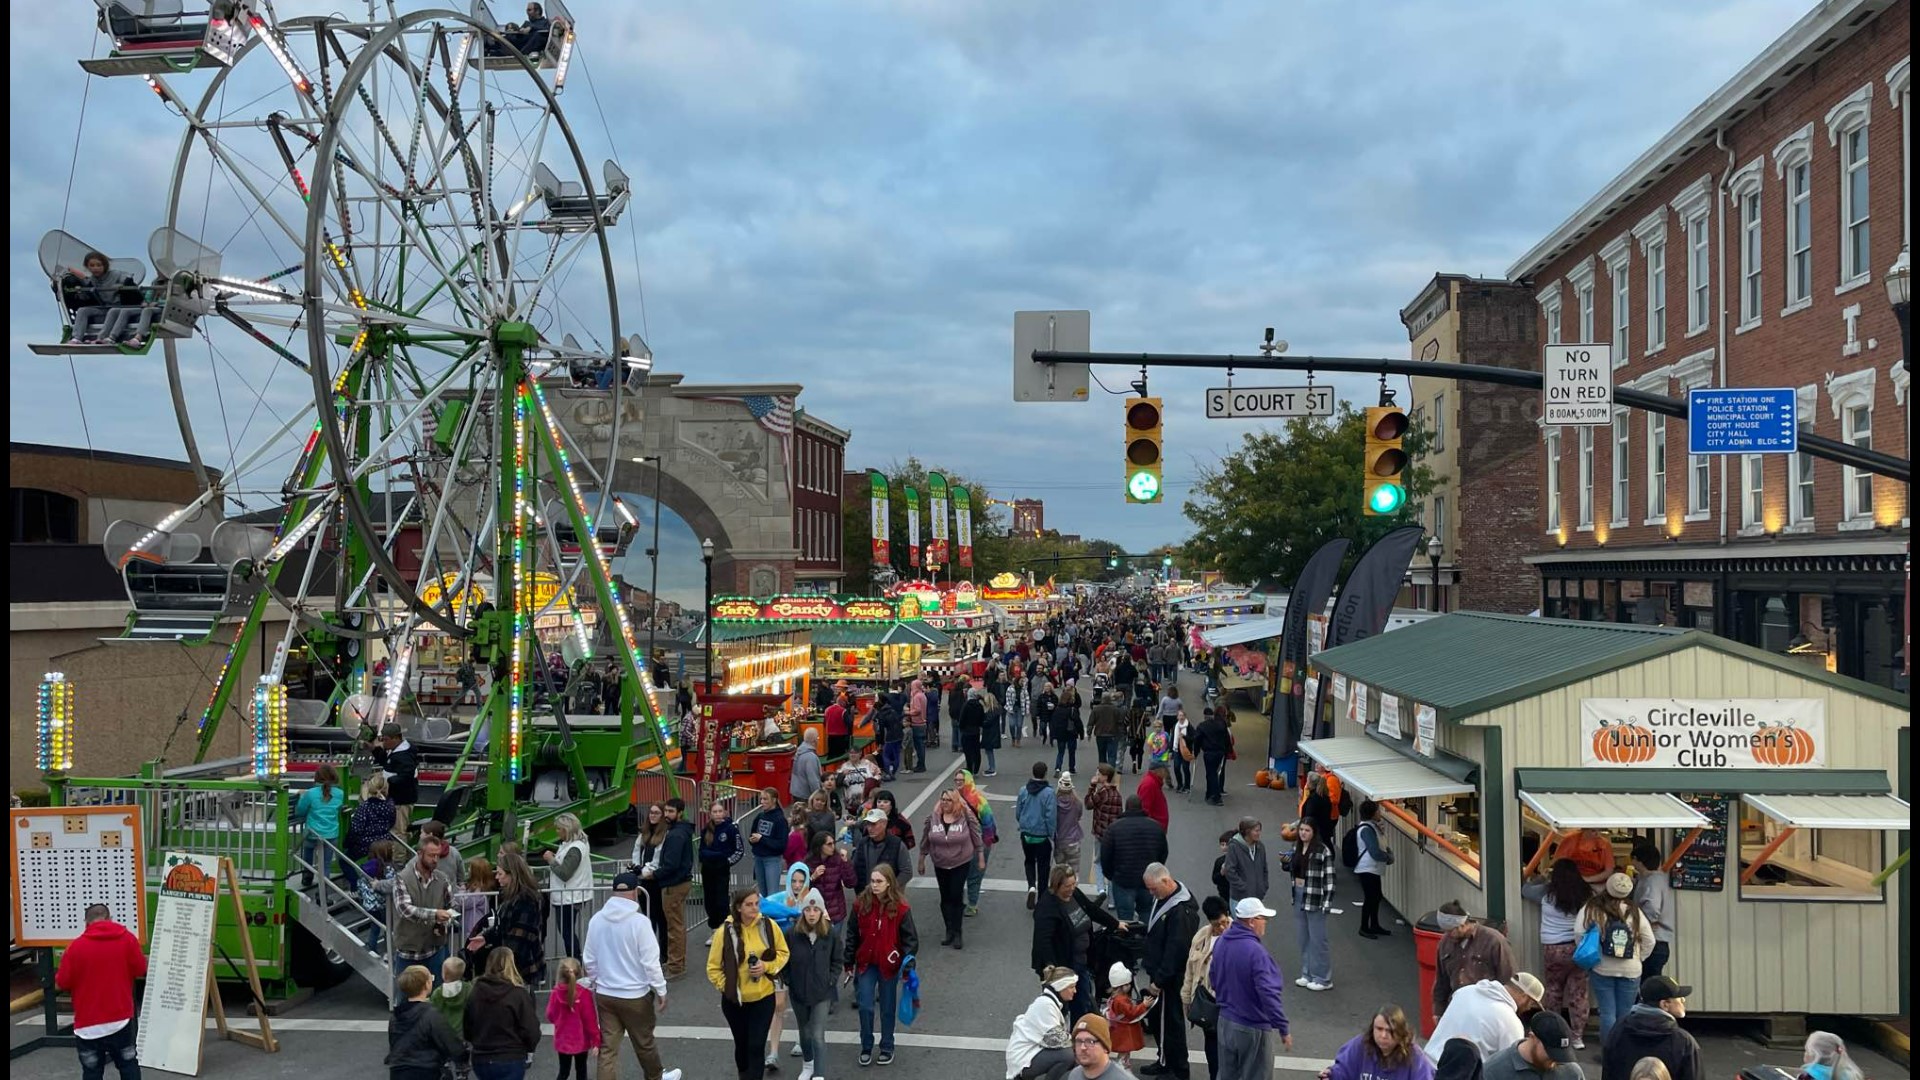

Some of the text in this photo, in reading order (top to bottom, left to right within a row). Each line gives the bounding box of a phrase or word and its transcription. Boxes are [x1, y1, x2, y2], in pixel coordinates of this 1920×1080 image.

[1566, 350, 1591, 363] NO
[1559, 368, 1598, 381] TURN
[1550, 386, 1606, 399] ON RED
[1213, 393, 1328, 412] S COURT ST
[717, 605, 758, 617] Taffy
[772, 603, 833, 617] Candy
[847, 606, 890, 618] Fudge
[1647, 708, 1756, 727] Circleville
[1611, 730, 1793, 748] Junior Women's
[1677, 749, 1727, 767] Club
[887, 950, 900, 964] C
